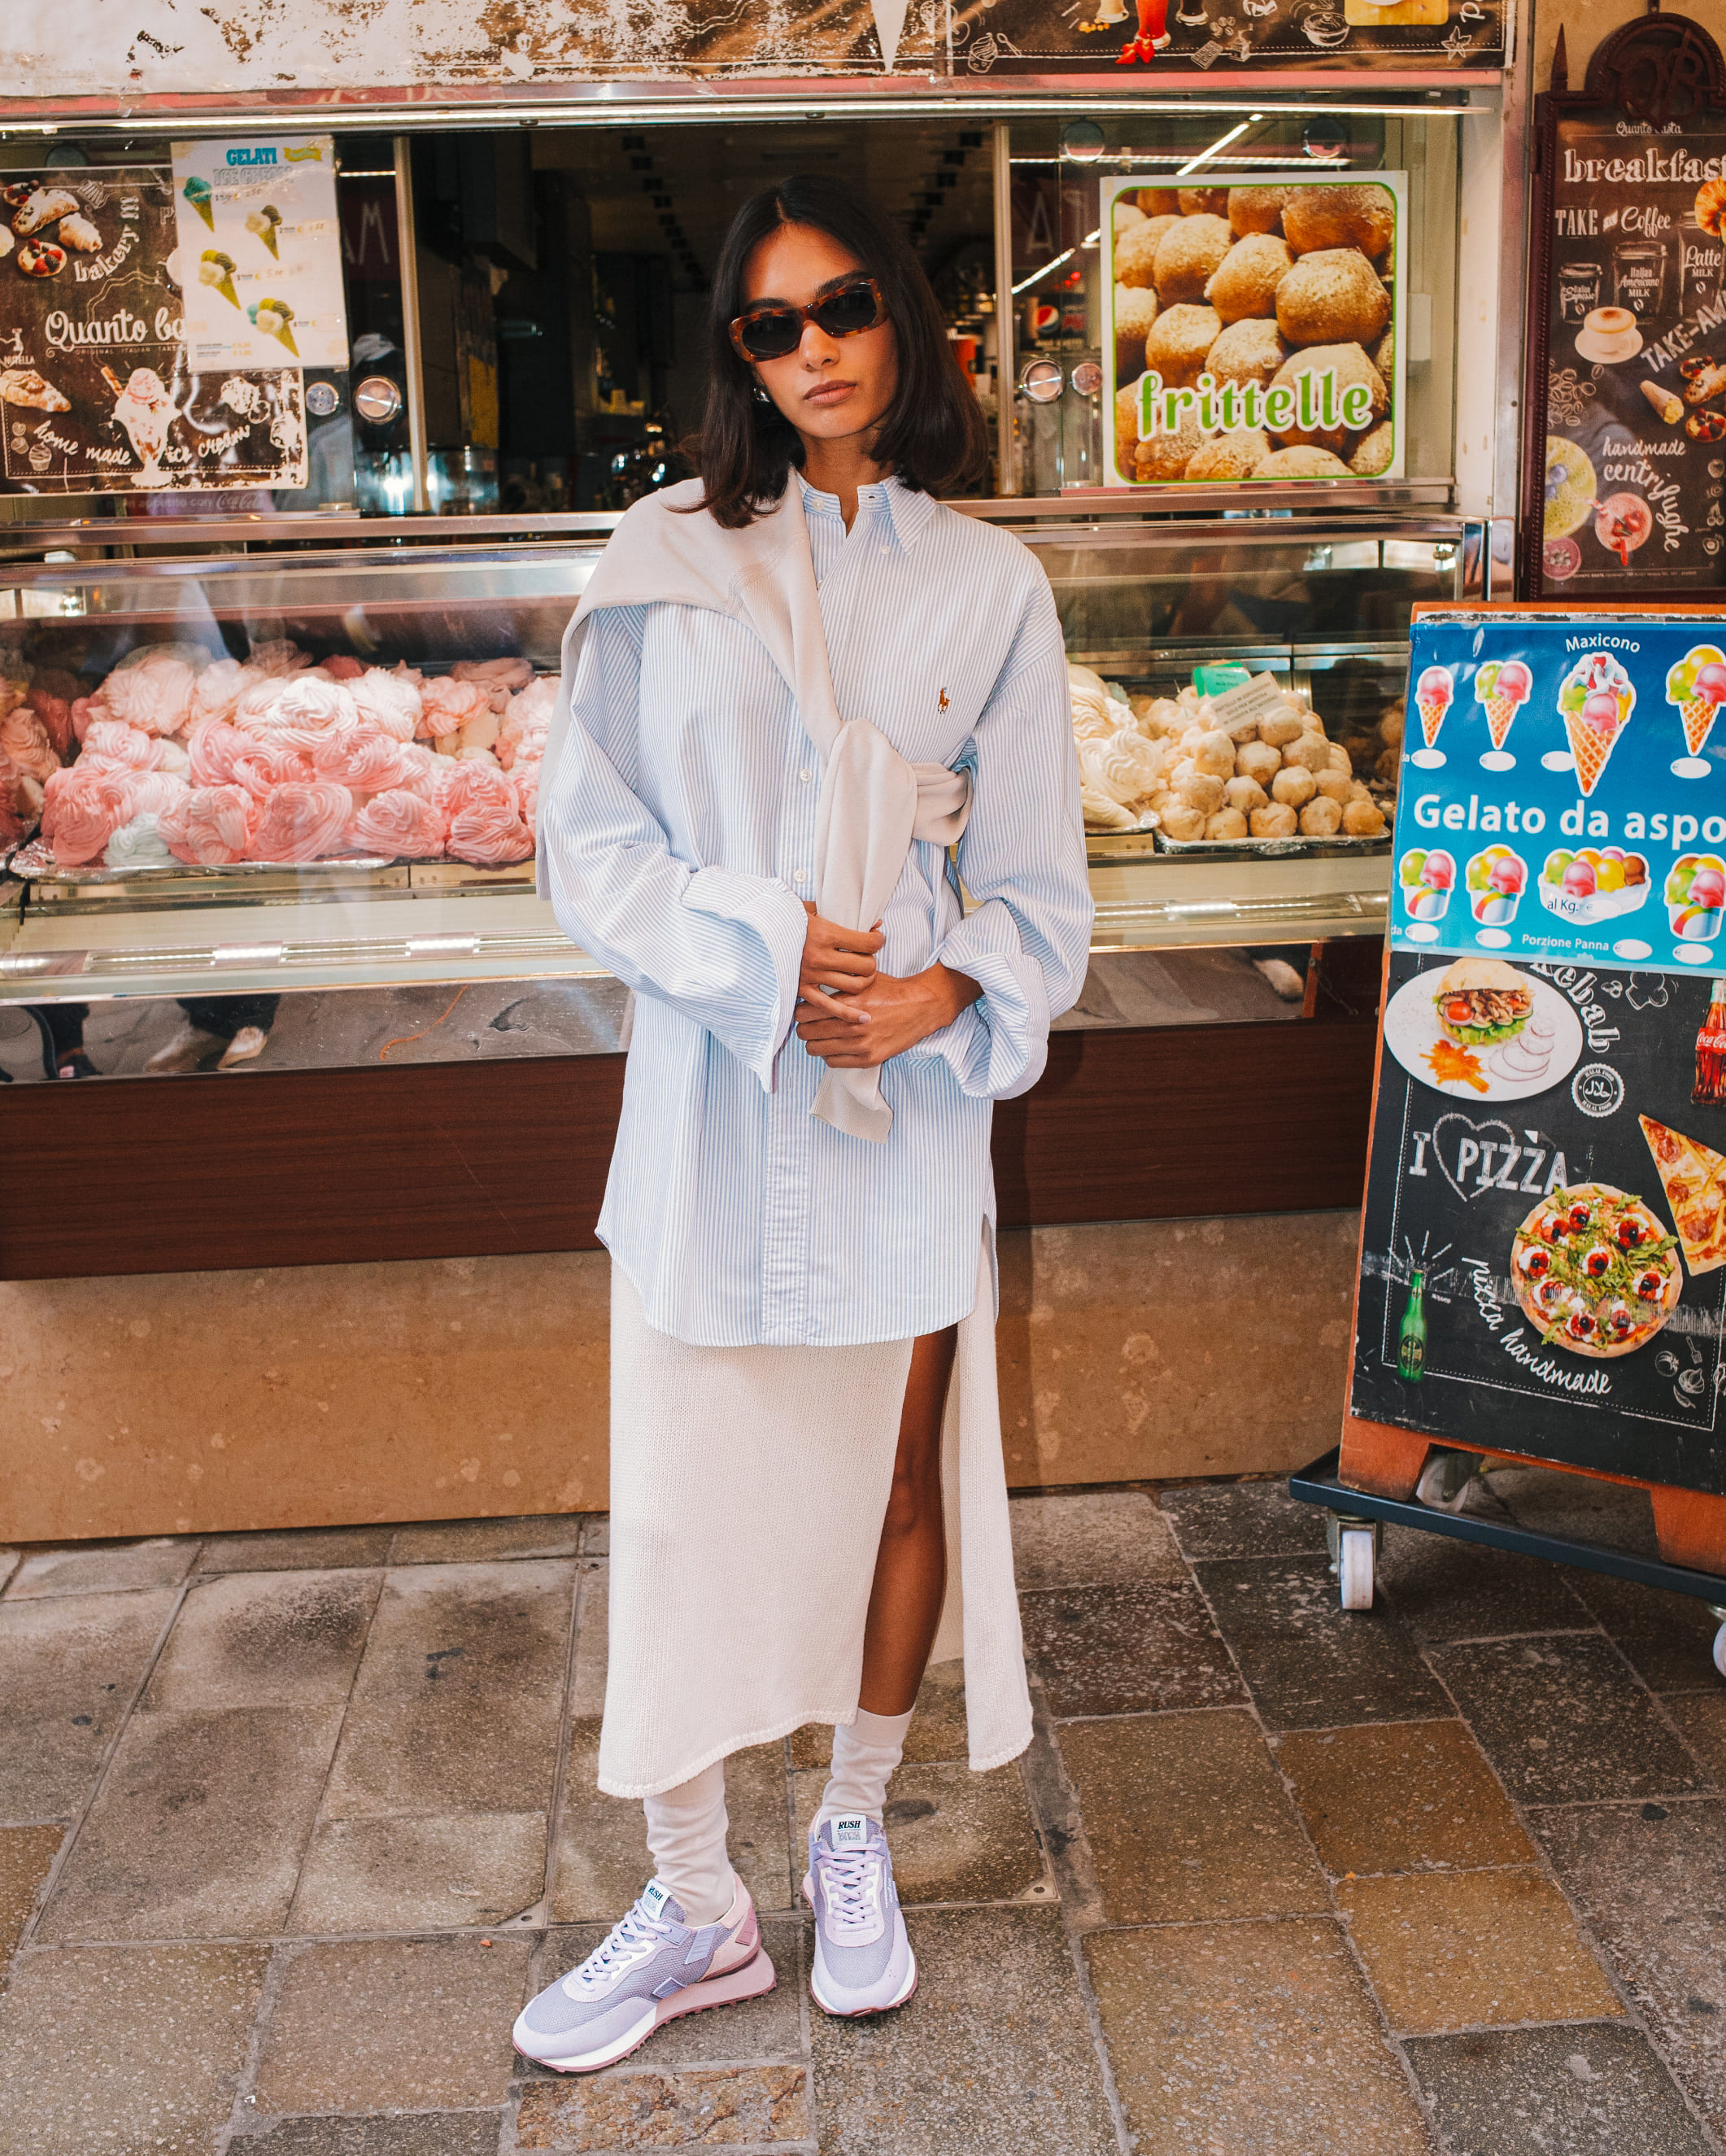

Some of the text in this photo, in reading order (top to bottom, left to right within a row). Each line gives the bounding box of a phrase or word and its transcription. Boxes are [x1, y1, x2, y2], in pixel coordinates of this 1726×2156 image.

[226, 147, 277, 166] GELATI
[1555, 206, 1671, 238] TAKE Coffee
[73, 224, 140, 282] bakery
[1684, 245, 1722, 268] Latte
[1692, 268, 1714, 277] MILK
[1628, 289, 1650, 298] MILK
[45, 310, 149, 352] Quanto
[1137, 370, 1371, 440] frittelle
[33, 420, 79, 456] home
[85, 447, 132, 465] made
[1602, 436, 1686, 457] handmade
[1603, 459, 1689, 552] centrifughe
[1565, 633, 1641, 653] Maxicono
[1413, 794, 1726, 850] Gelato da aspo
[1547, 899, 1558, 910] al
[1560, 898, 1580, 914] Kg.
[1522, 934, 1571, 948] Porzione
[1575, 937, 1609, 950] Panna
[1584, 1080, 1610, 1098] حلال
[1409, 1131, 1568, 1196] I PIZZA
[1462, 1257, 1504, 1330] pizza
[1500, 1328, 1612, 1394] handmade
[838, 1820, 861, 1830] RUSH
[647, 1885, 664, 1901] RUSH
